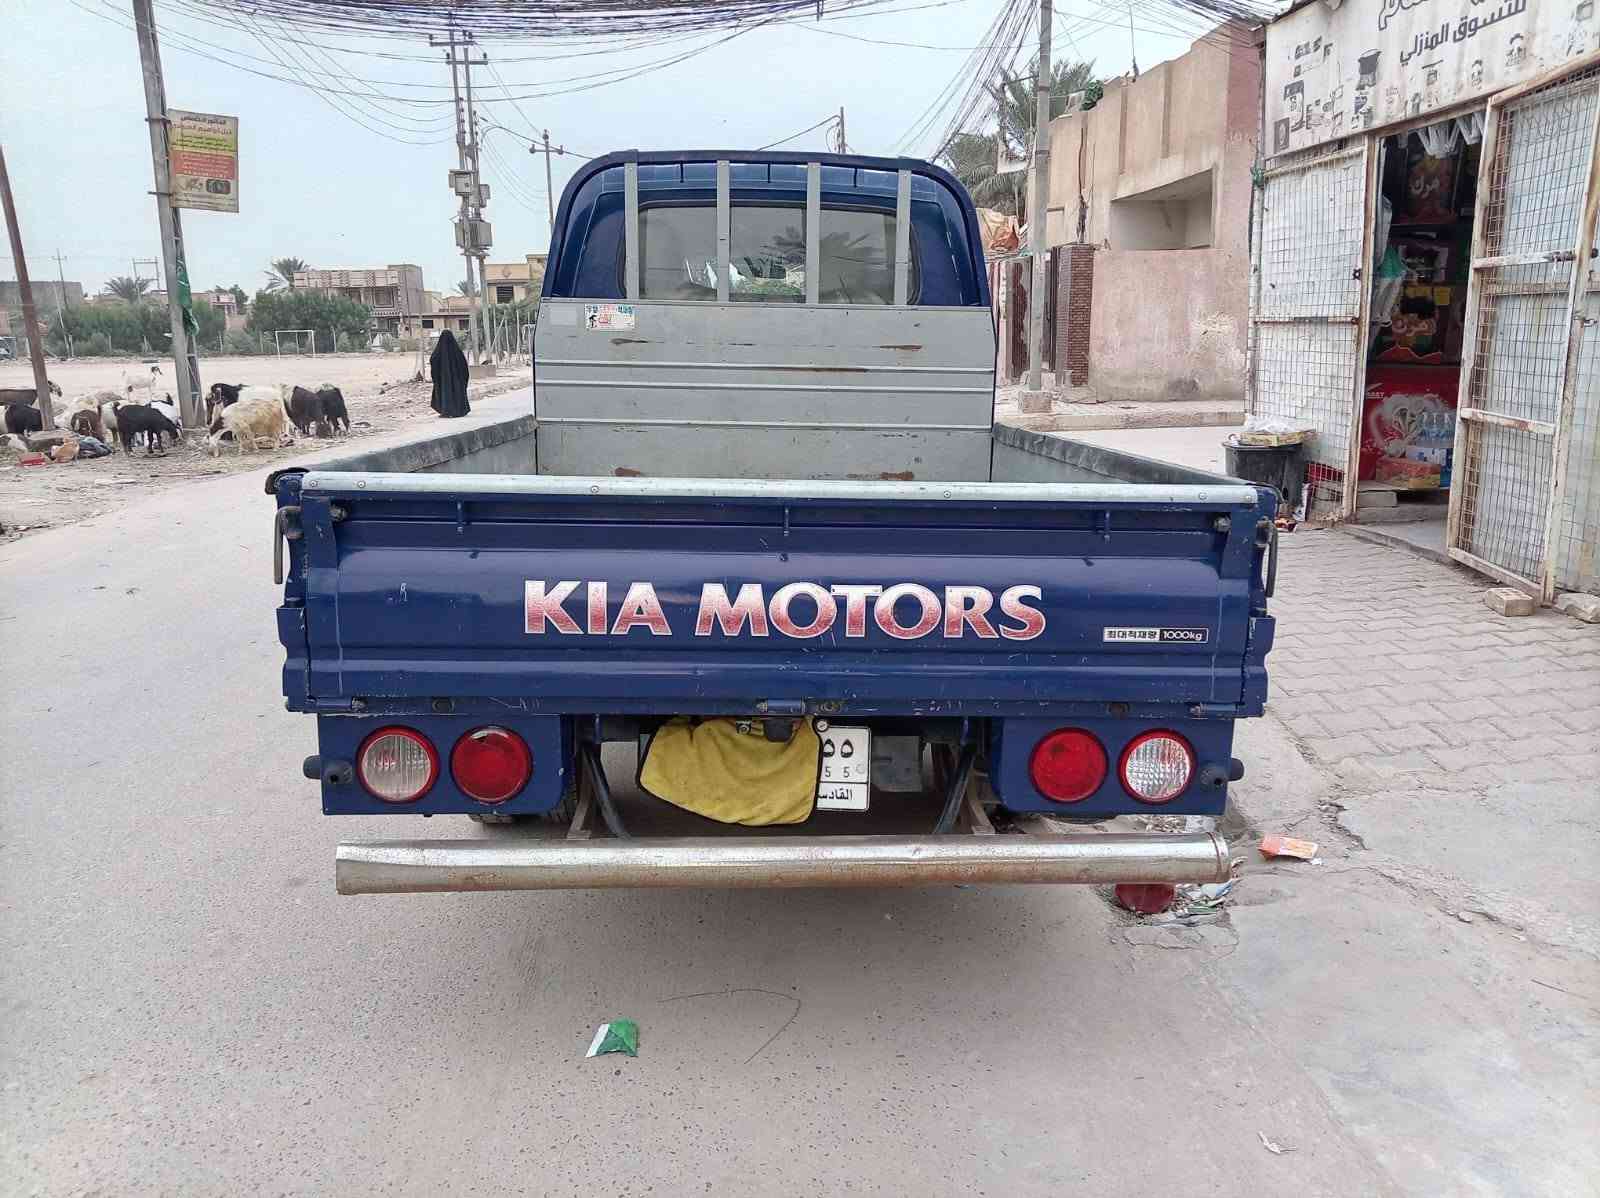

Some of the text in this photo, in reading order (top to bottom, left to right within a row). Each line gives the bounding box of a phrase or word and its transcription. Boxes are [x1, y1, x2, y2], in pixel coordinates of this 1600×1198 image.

[1399, 22, 1450, 66] المنزلي
[524, 580, 1047, 641] KIA MOTORS
[1163, 630, 1203, 641] 1000kg
[817, 788, 853, 799] القادس
